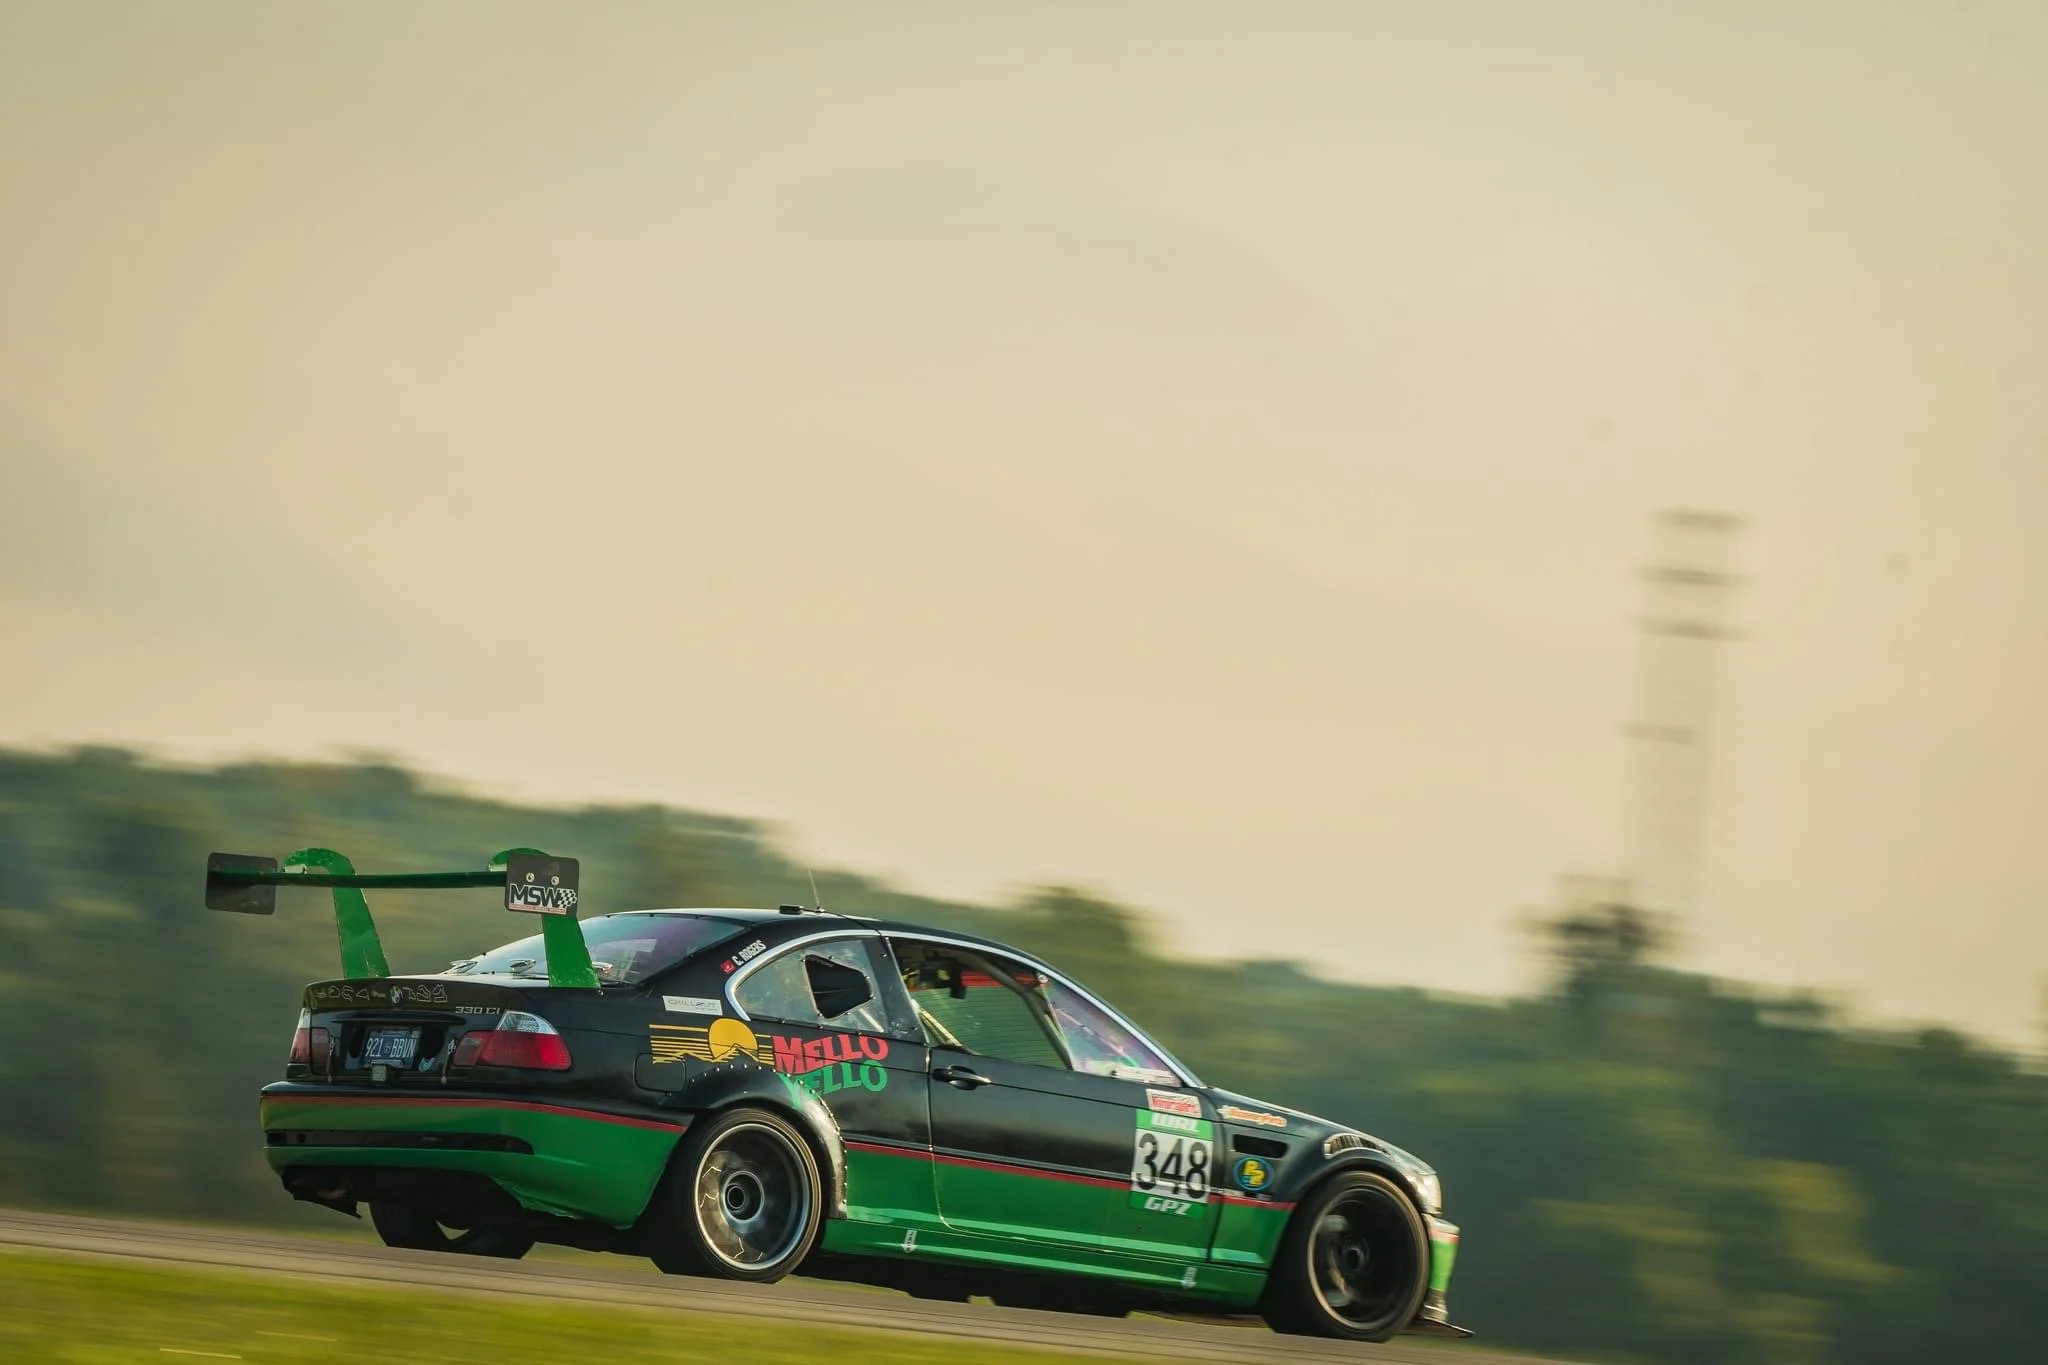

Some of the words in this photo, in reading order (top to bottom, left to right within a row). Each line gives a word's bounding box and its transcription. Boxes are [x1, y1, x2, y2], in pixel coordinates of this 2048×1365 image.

[509, 884, 561, 907] MSW
[455, 1006, 483, 1014] 330
[365, 1037, 384, 1057] 921
[390, 1038, 417, 1058] BBVN
[772, 1034, 889, 1075] MELLO
[776, 1060, 888, 1111] YELLO
[1137, 1133, 1208, 1199] 348
